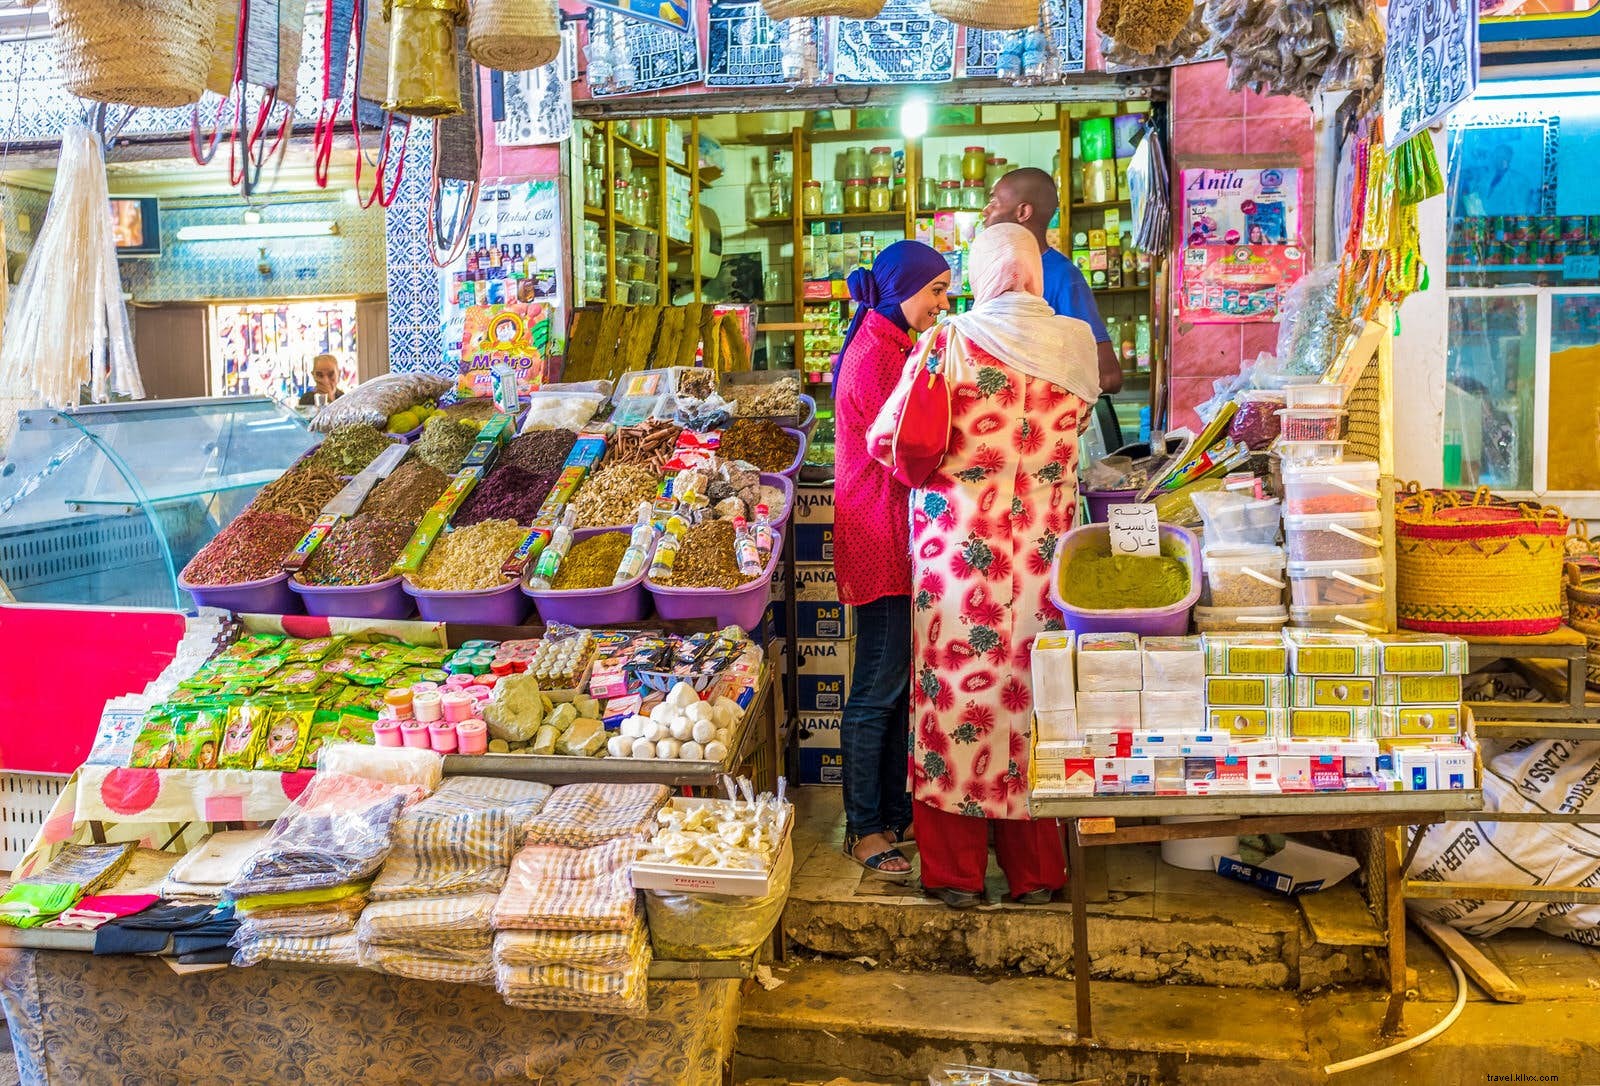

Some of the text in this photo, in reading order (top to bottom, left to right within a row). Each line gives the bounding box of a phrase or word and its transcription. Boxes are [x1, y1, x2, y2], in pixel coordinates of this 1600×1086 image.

[1187, 170, 1243, 191] Anila
[817, 607, 840, 619] D&B
[817, 681, 840, 692] D&B
[1528, 742, 1570, 784] CLASS
[1520, 779, 1541, 794] A
[1558, 783, 1594, 814] RICE
[1440, 827, 1481, 872] SELLER
[1230, 864, 1253, 877] PINE
